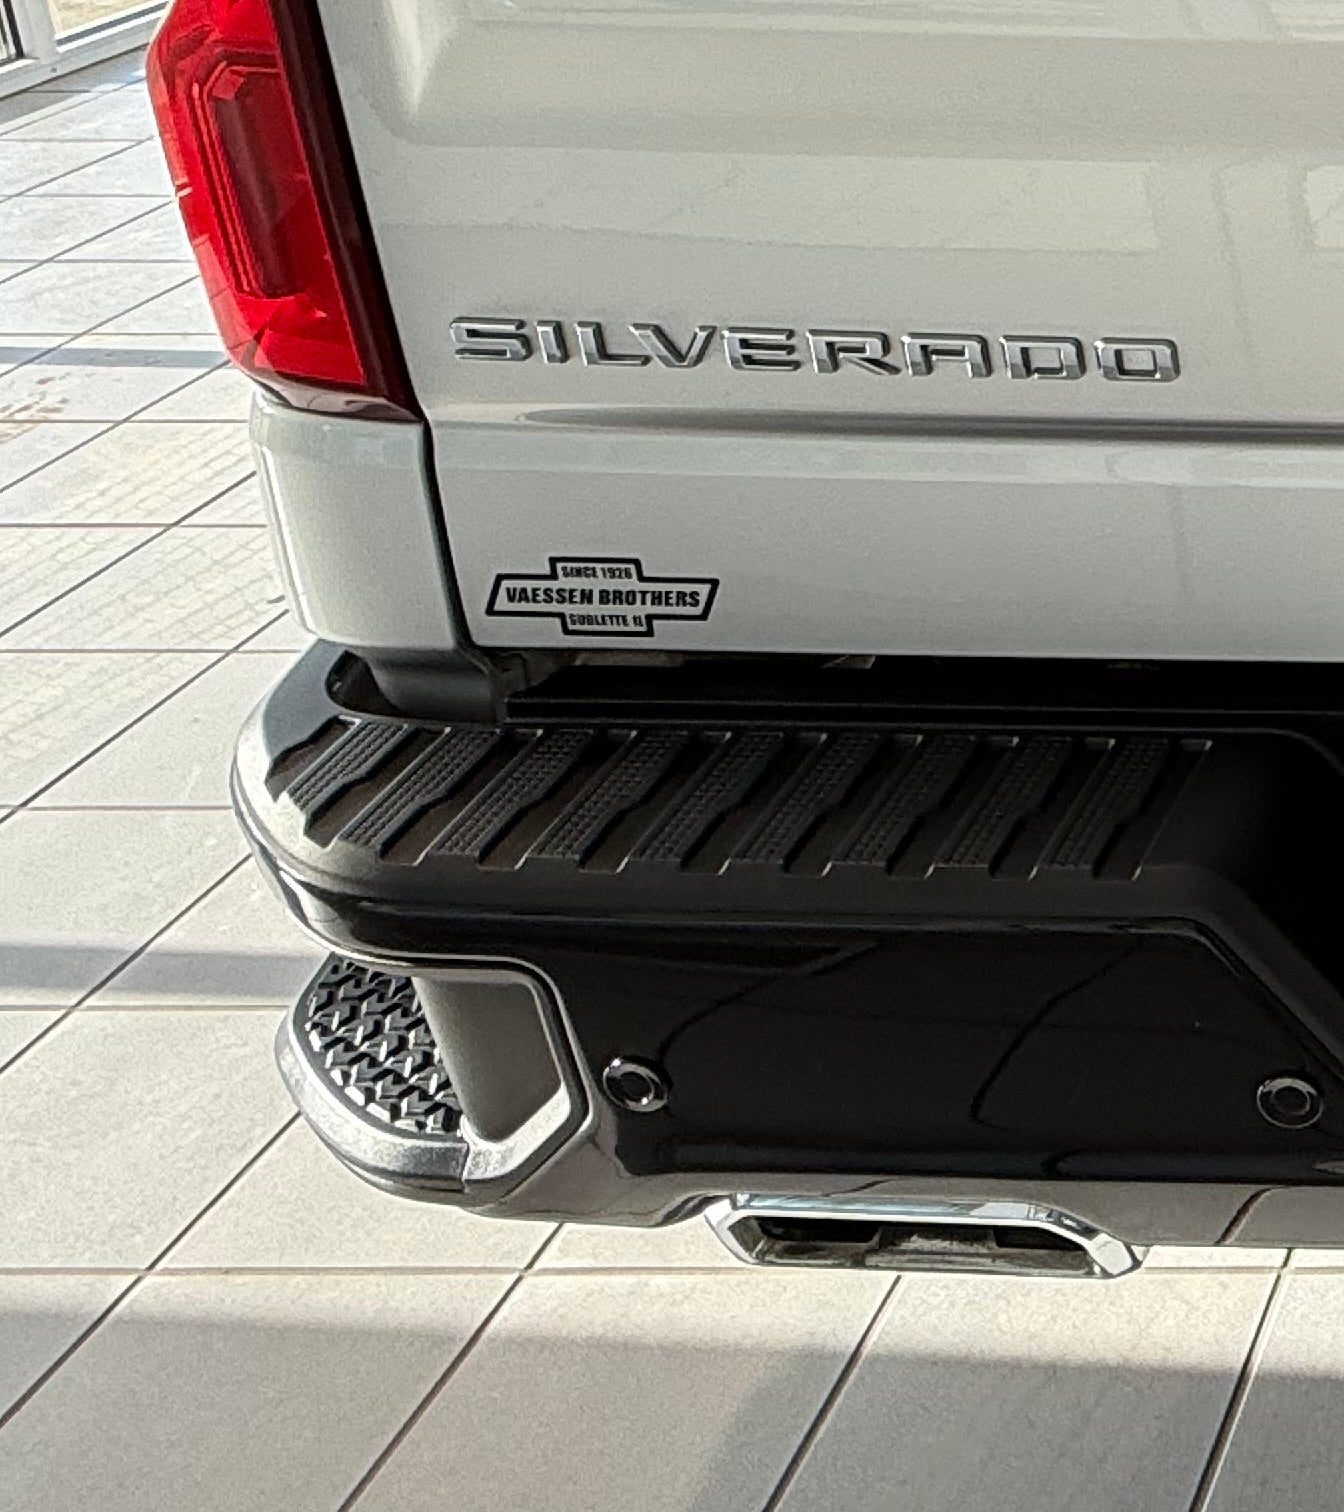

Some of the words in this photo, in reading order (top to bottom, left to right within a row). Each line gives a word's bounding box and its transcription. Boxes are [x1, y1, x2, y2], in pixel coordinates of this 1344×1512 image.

[449, 314, 1182, 382] SILVERADO
[560, 565, 598, 579] SINCE
[505, 586, 594, 606] VAESSEN
[598, 588, 700, 608] BROTHERS
[568, 613, 629, 627] SUBLETTE
